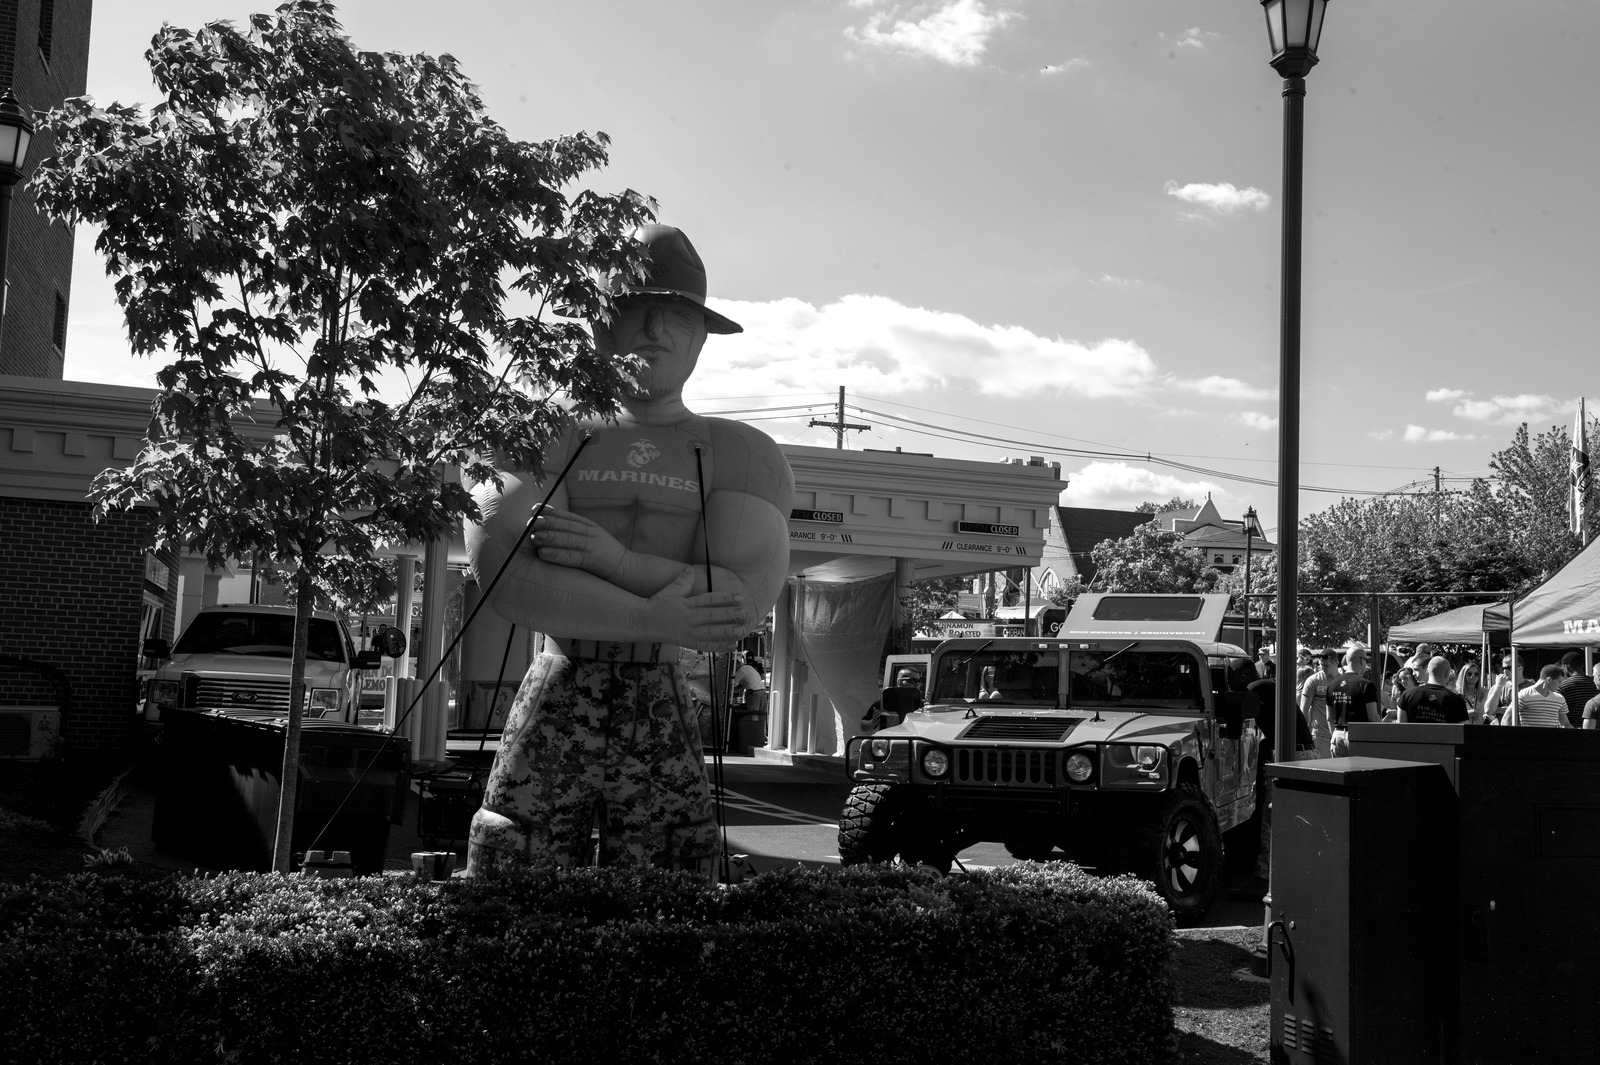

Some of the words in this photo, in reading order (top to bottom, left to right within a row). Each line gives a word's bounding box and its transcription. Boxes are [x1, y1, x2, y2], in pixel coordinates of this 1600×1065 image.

[577, 470, 699, 492] MARINES
[813, 511, 842, 521] CLOSED
[990, 525, 1018, 535] CLOSED
[956, 542, 993, 552] CLEARANCE
